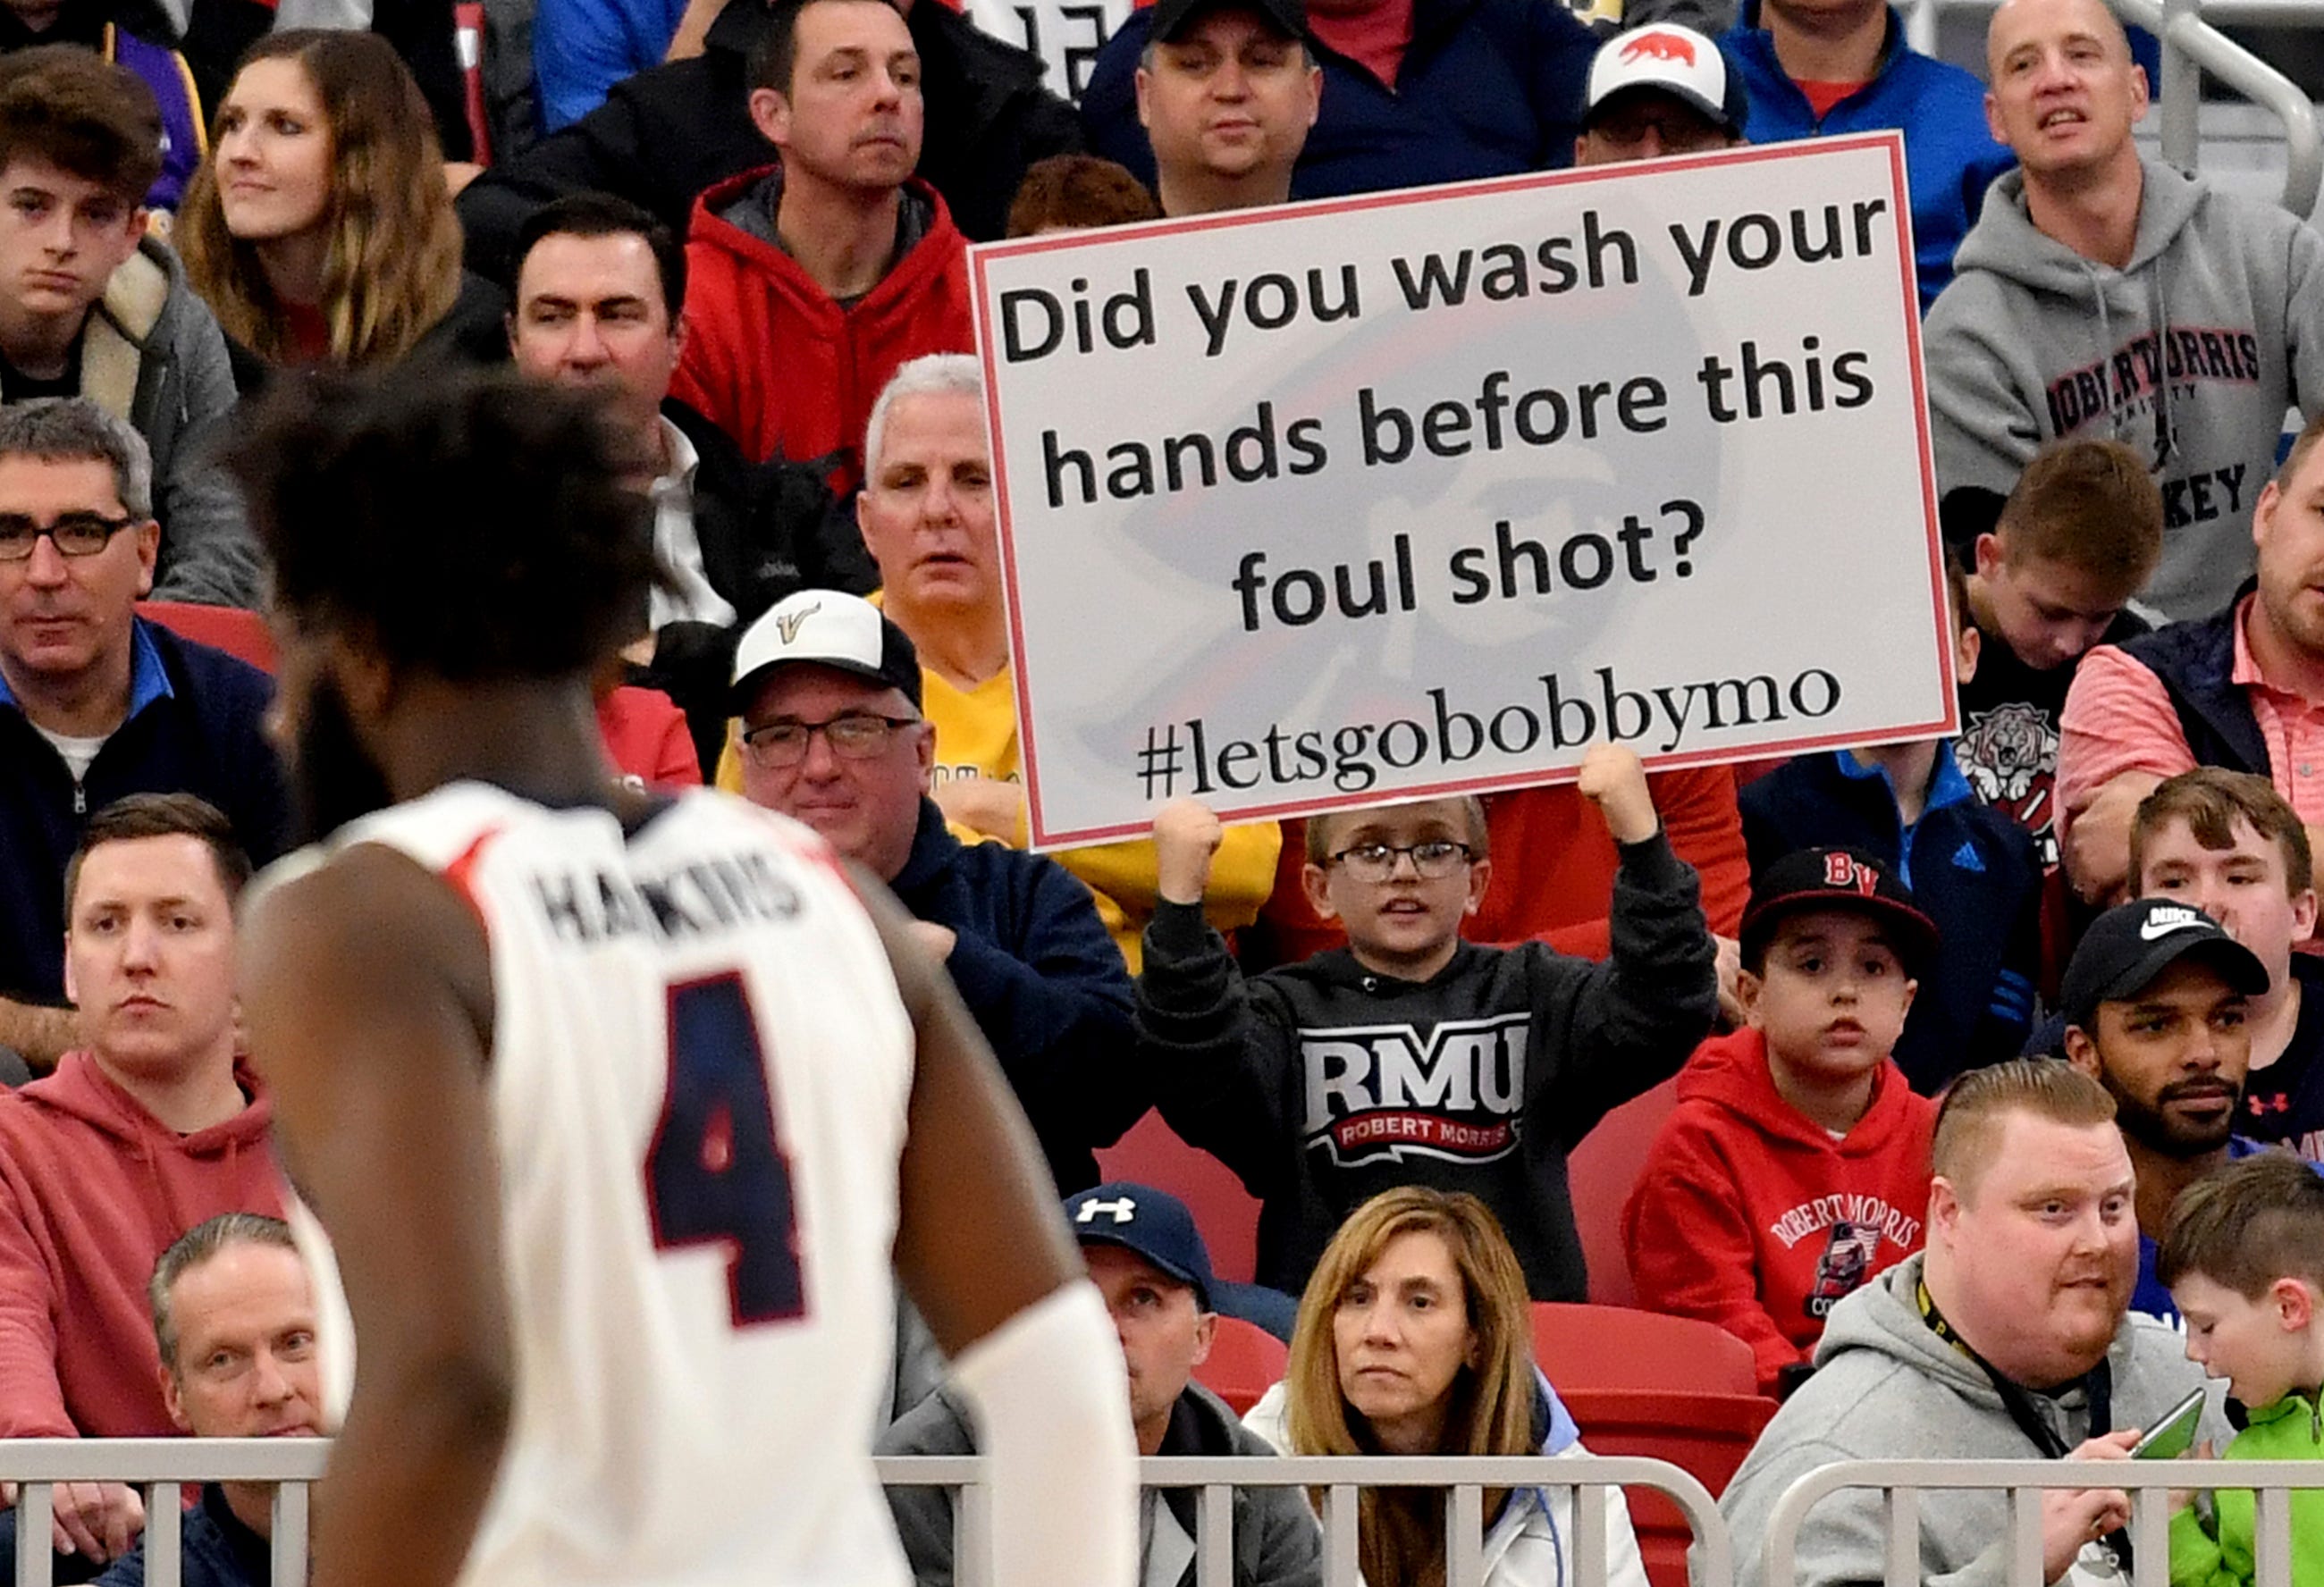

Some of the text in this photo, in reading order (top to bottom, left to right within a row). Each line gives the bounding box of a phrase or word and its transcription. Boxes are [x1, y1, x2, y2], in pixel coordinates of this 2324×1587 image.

[1000, 198, 1886, 363] Did you wash your
[1042, 336, 1874, 508] hands before this
[2163, 464, 2246, 530] KEY
[1232, 500, 1705, 631] foul shot?
[1137, 667, 1841, 800] #letsgobobbymo
[2151, 907, 2197, 926] NIKE
[1301, 1025, 1529, 1134] RMU
[1342, 1117, 1506, 1146] ROBERT MORRIS
[644, 970, 809, 1329] 4
[1771, 1193, 1920, 1251] ROBERT MORRIS
